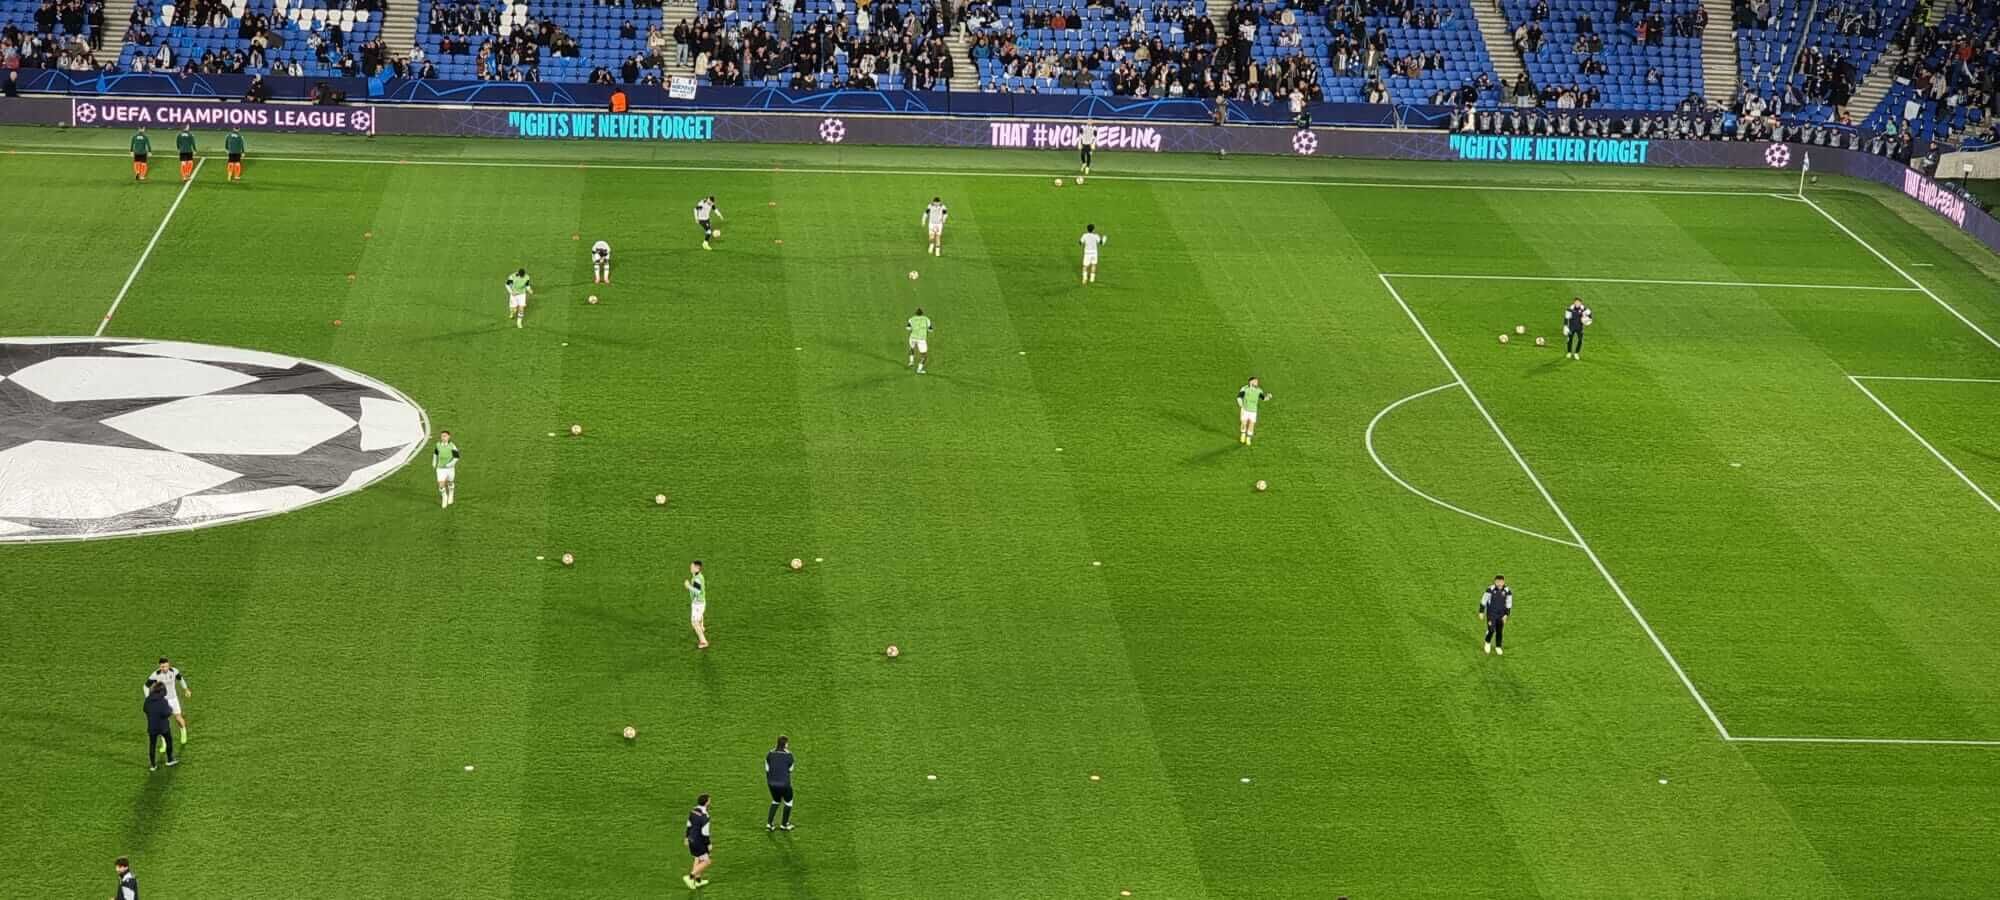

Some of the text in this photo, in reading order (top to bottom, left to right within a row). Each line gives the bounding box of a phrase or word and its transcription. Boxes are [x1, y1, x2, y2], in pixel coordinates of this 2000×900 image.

[101, 106, 346, 128] UEFA CHAMPIONS LEAGUE
[572, 113, 595, 137] WE
[599, 114, 650, 139] NEVER
[652, 115, 715, 140] FORGET
[990, 122, 1161, 152] THAT #UCLEELING
[1510, 136, 1534, 161] WE
[1536, 137, 1586, 162] NEVER
[1588, 138, 1649, 164] FORGET
